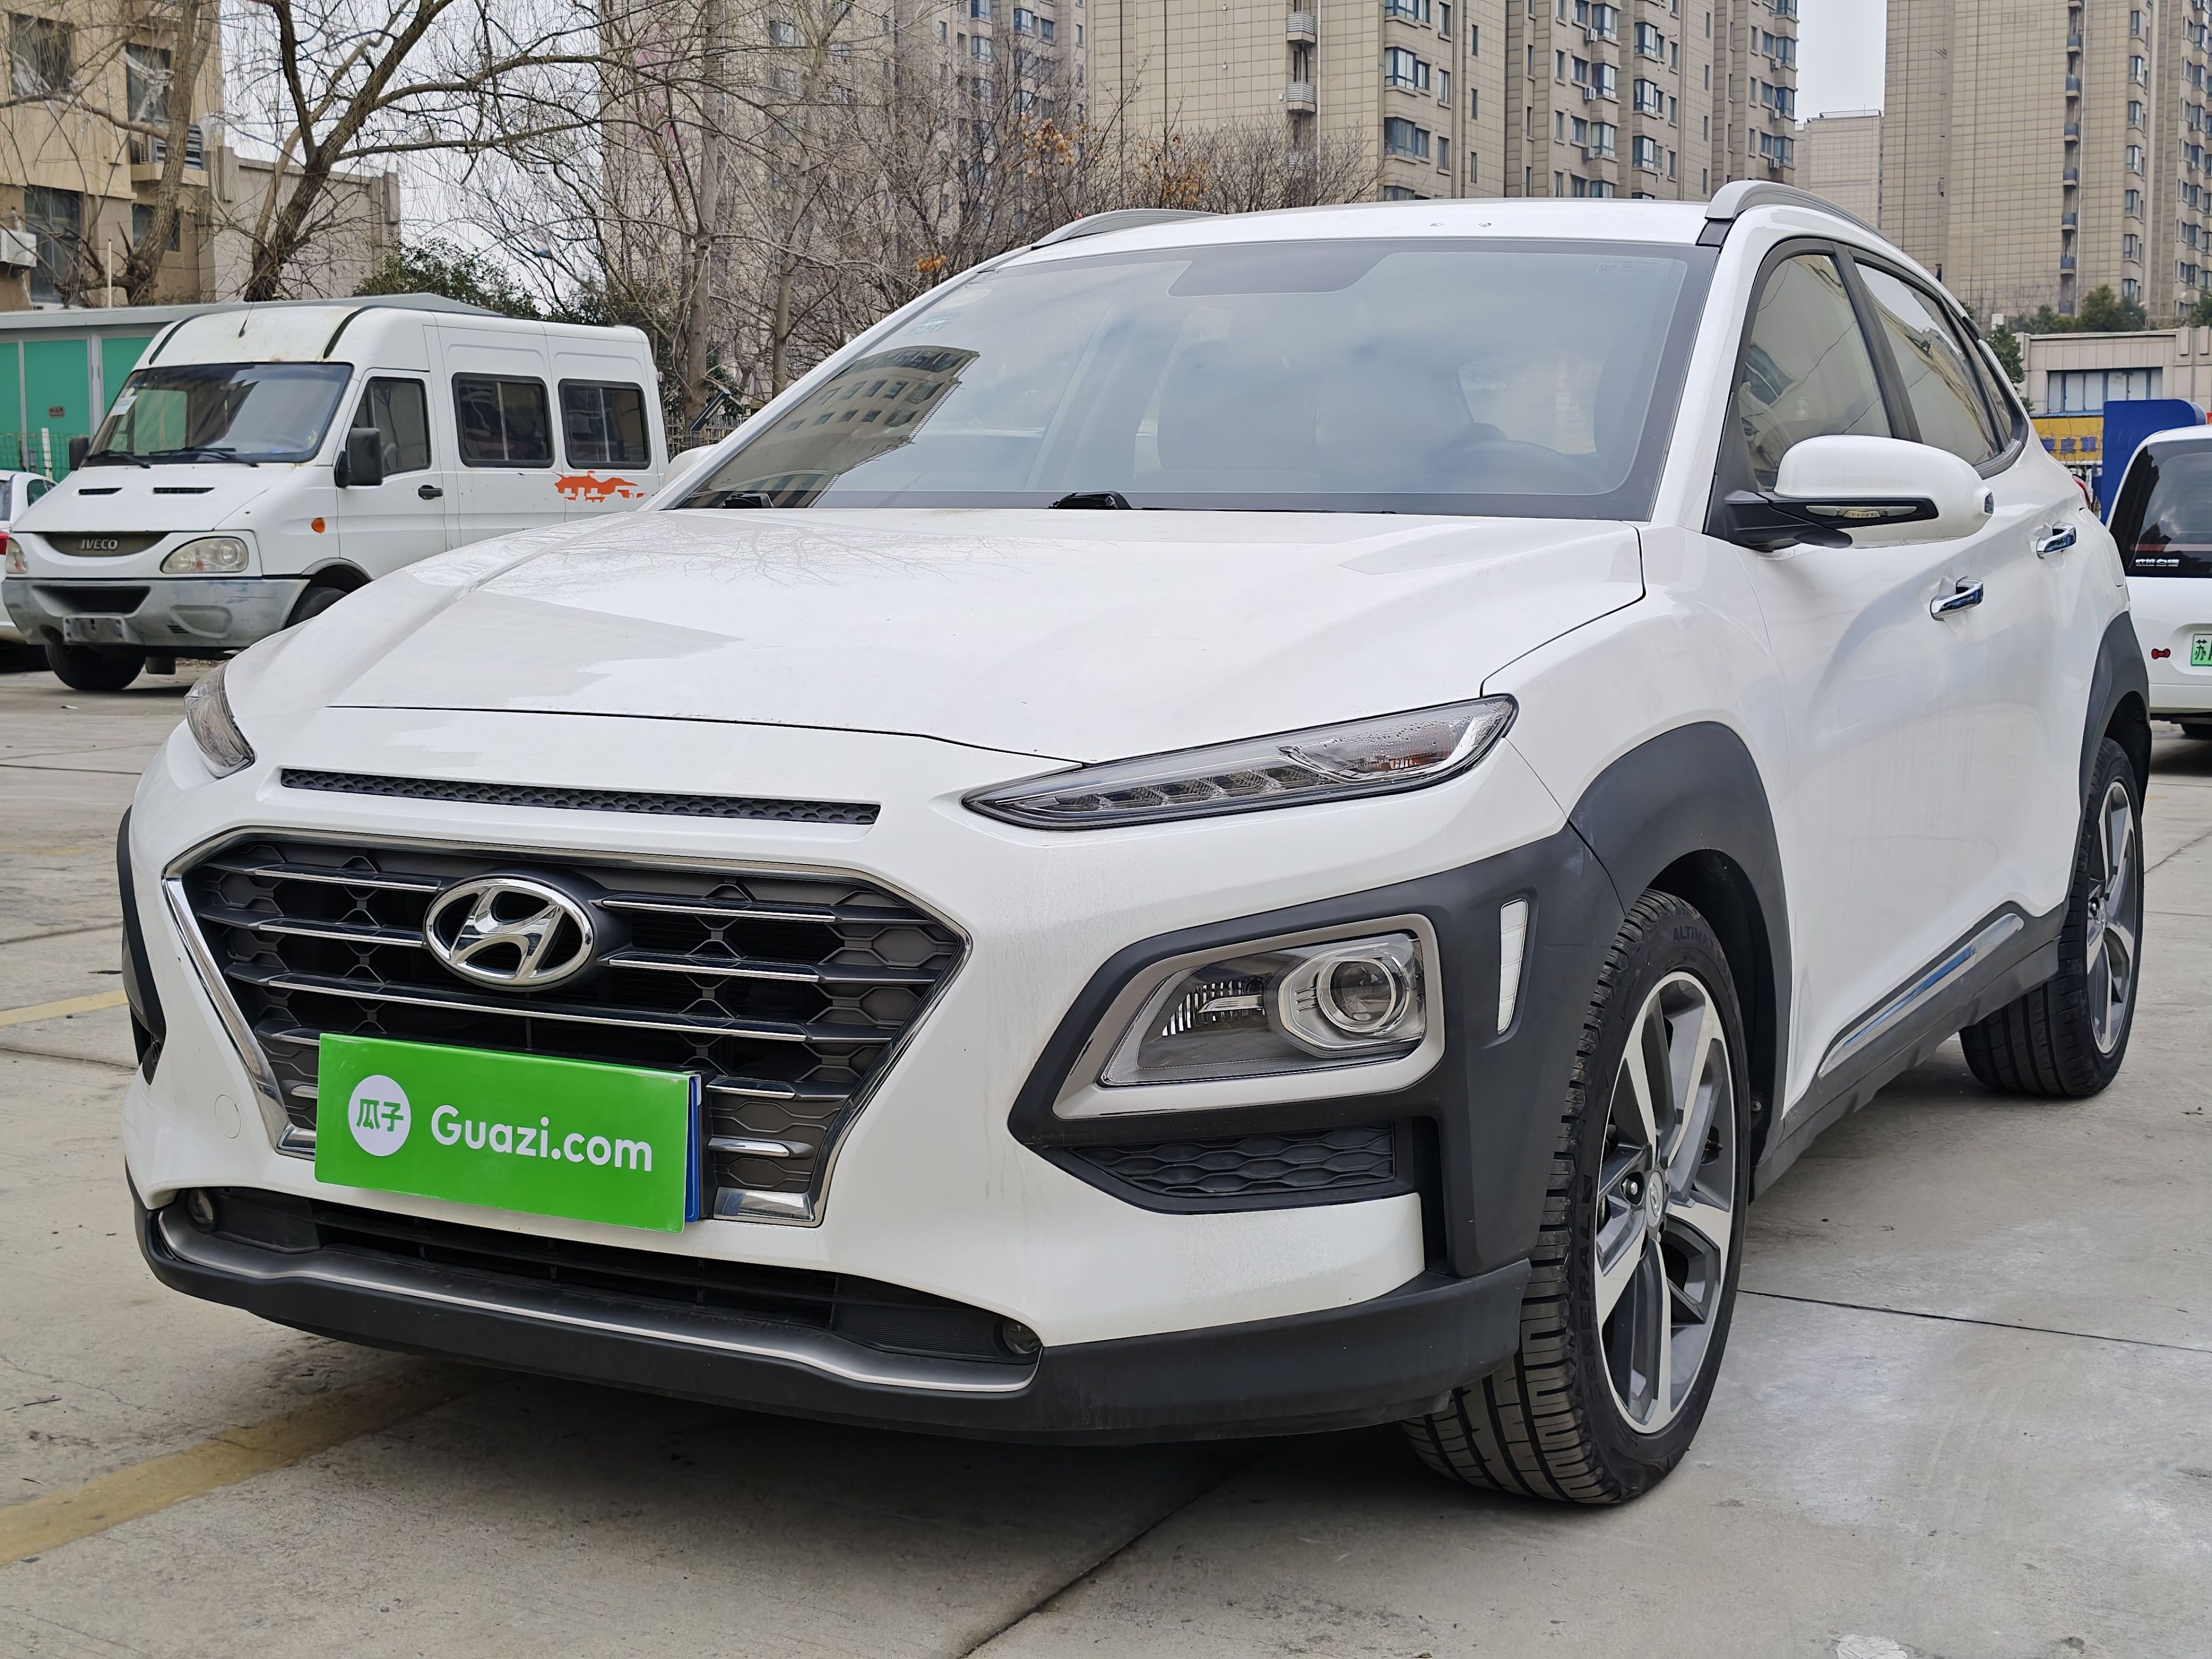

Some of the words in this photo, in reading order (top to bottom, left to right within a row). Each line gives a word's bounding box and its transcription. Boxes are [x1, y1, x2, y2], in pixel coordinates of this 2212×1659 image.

[81, 539, 118, 550] IVECO
[2194, 639, 2212, 661] 苏
[356, 1098, 404, 1132] 瓜子
[431, 1104, 653, 1172] Guazi.com
